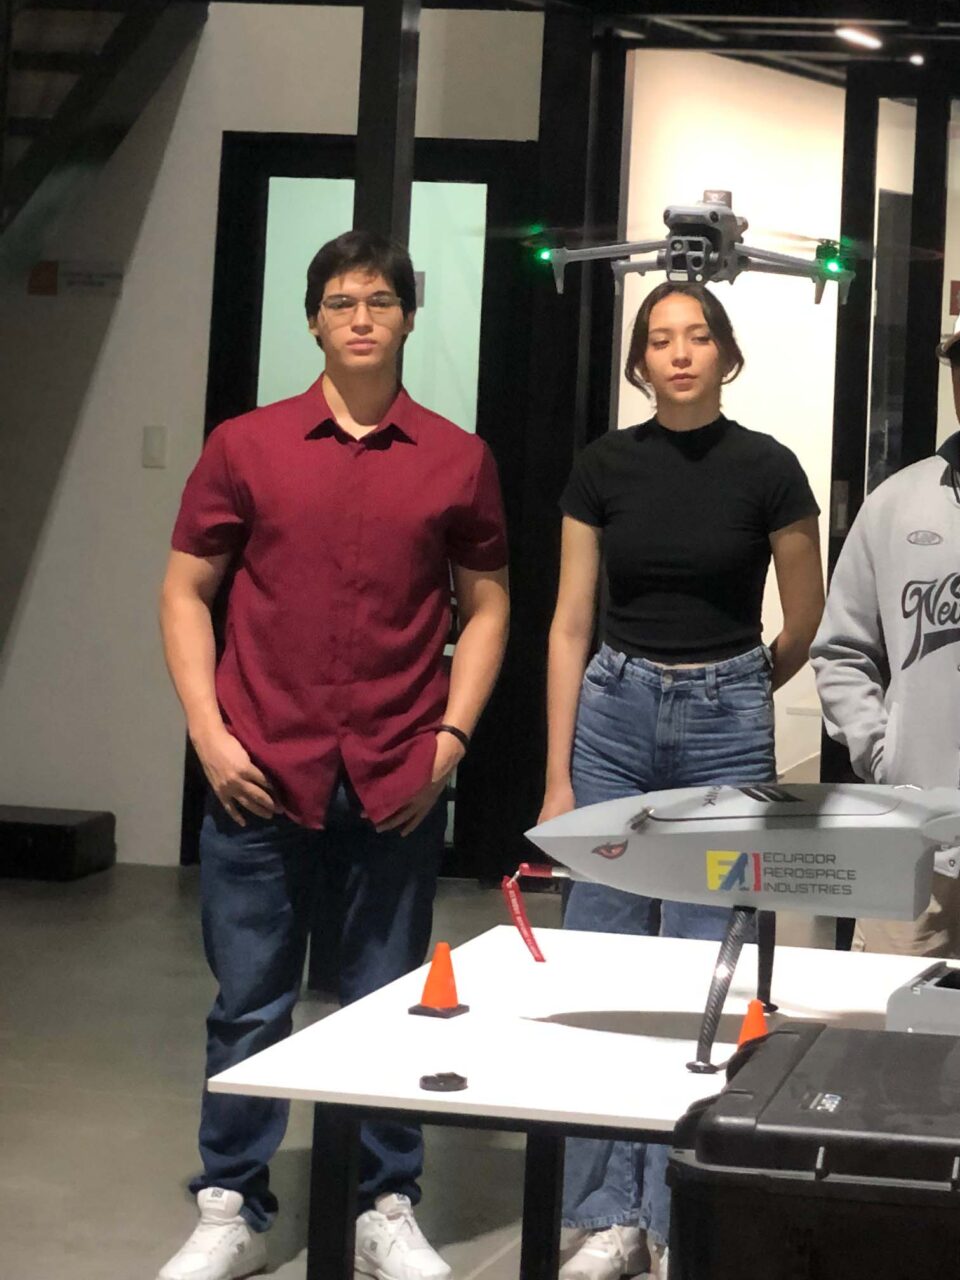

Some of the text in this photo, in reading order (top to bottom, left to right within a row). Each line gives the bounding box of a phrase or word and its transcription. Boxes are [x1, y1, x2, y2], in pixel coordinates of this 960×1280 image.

[763, 852, 837, 864] ECUADOR
[763, 867, 857, 881] AEROSPACE
[763, 882, 853, 896] INDUSTRIES
